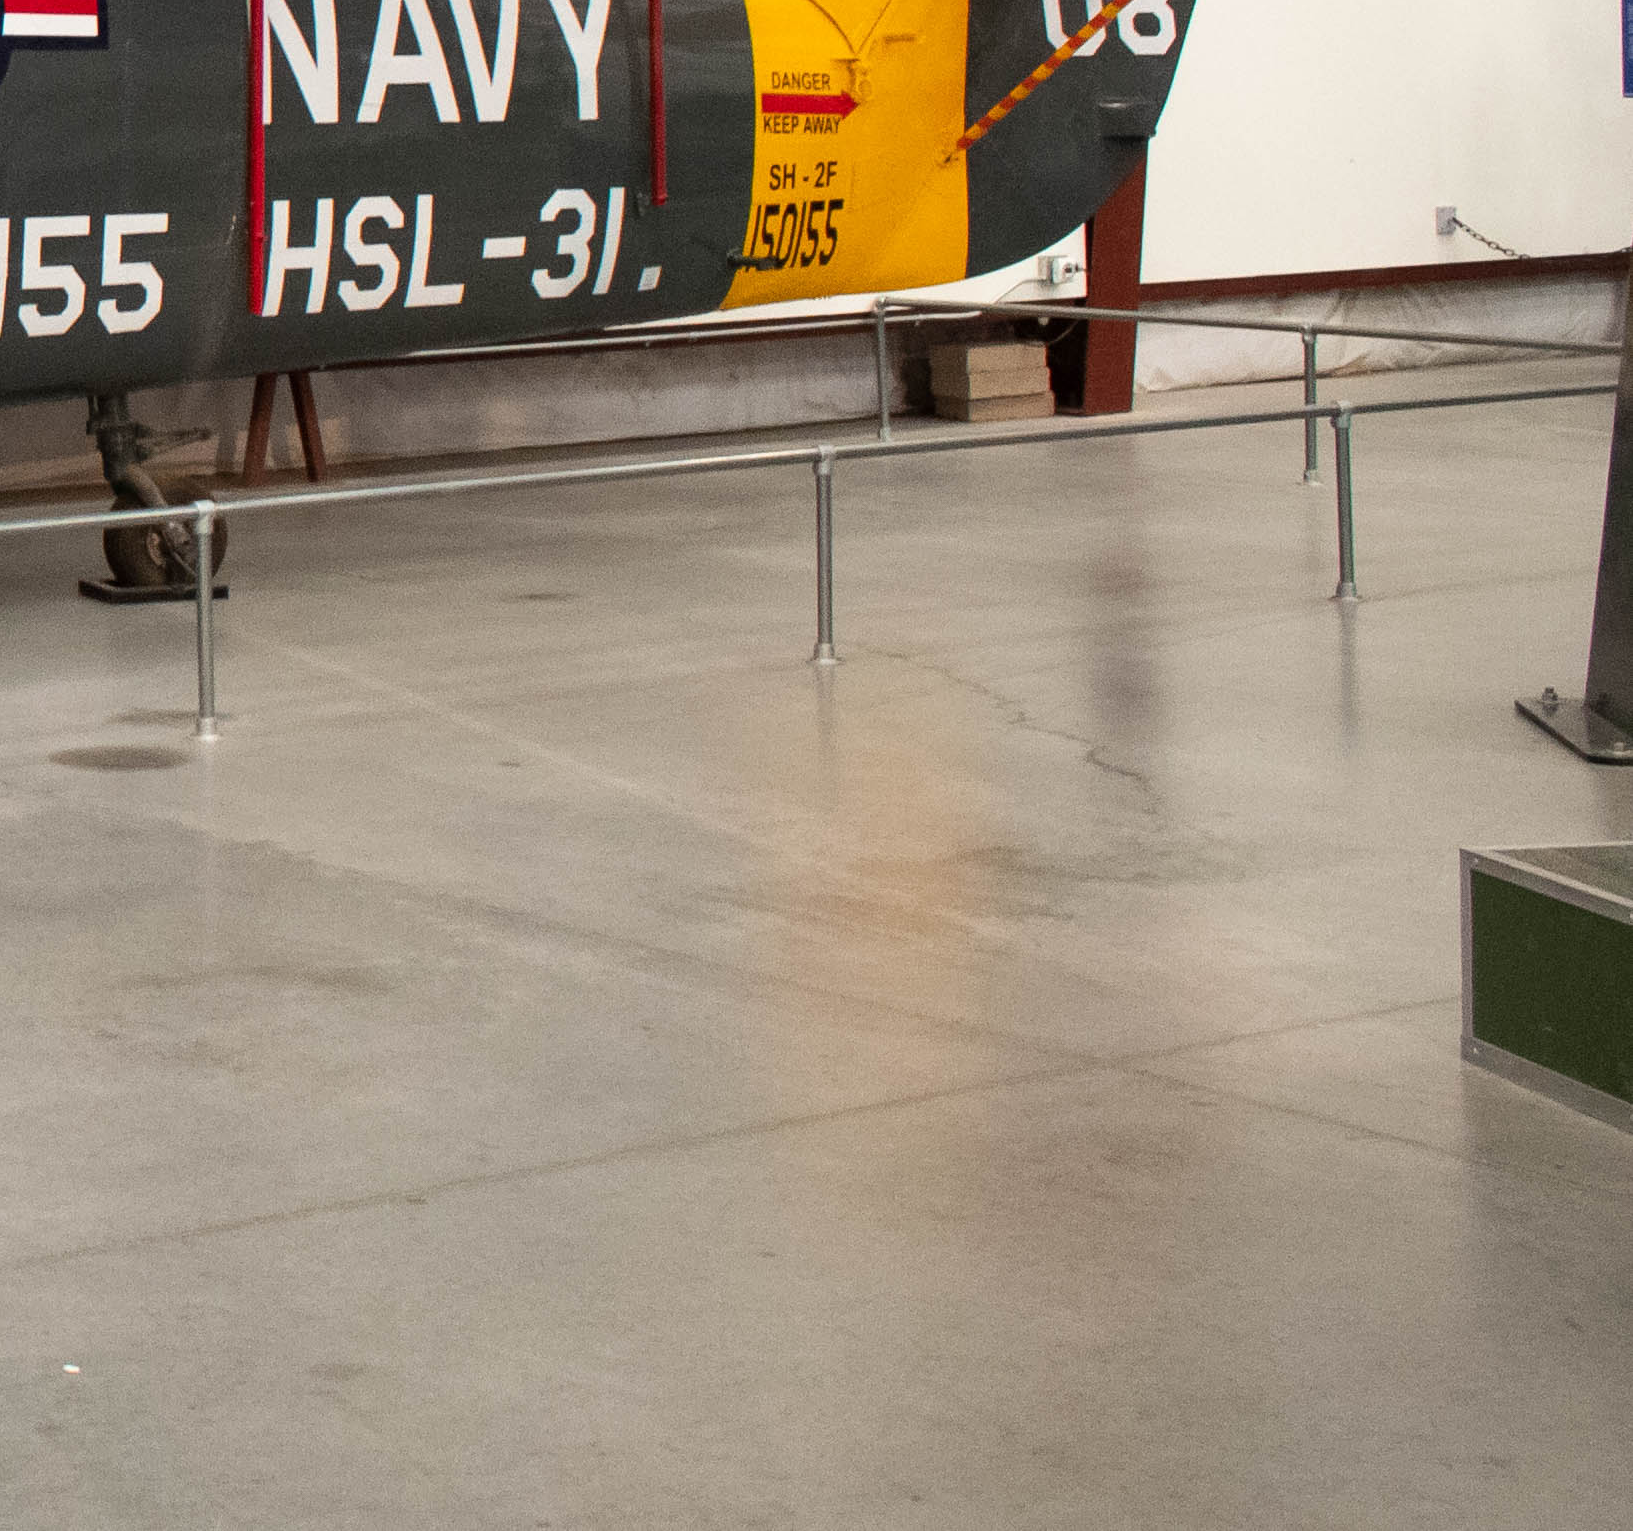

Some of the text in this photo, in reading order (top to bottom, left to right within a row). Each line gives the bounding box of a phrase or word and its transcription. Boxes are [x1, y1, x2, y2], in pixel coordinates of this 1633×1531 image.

[771, 71, 831, 90] DANGER
[763, 114, 841, 134] KEEP AWAY
[746, 198, 844, 271] 150155
